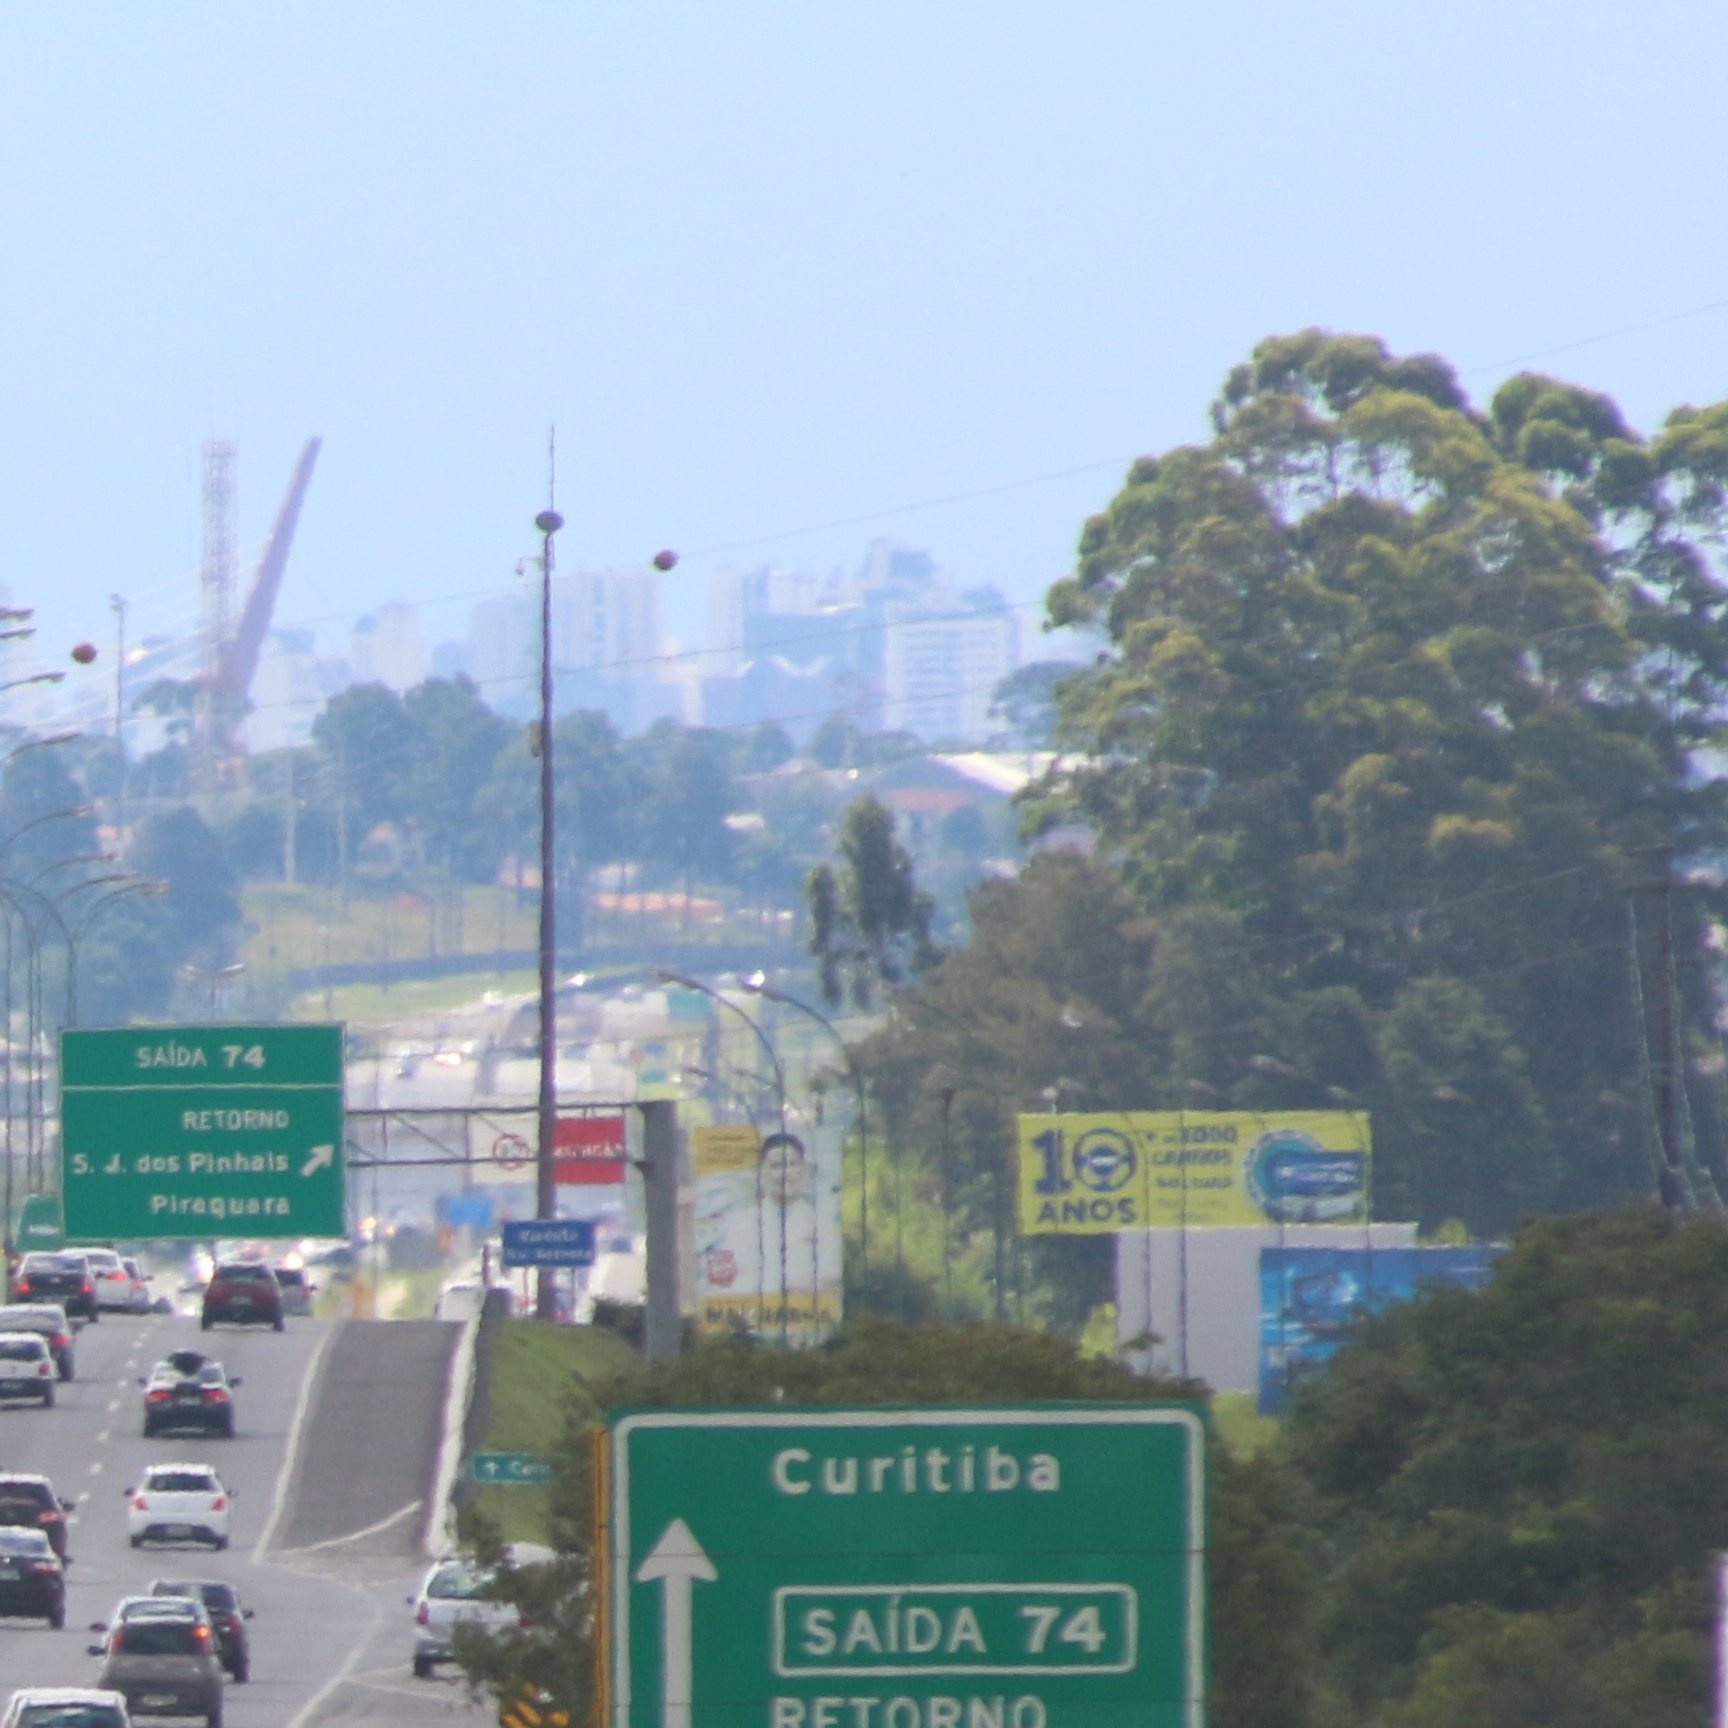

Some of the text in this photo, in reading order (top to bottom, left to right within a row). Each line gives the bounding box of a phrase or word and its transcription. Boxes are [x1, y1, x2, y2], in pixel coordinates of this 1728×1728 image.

[136, 1041, 266, 1069] SAÍDA 74
[182, 1109, 289, 1131] RETORNO
[72, 1151, 289, 1175] S. J. dos Pinhais
[150, 1194, 291, 1218] Piraquara
[1035, 1199, 1137, 1224] ANOS
[771, 1447, 1061, 1494] Curitiba
[801, 1597, 1106, 1655] SAÍDA 74
